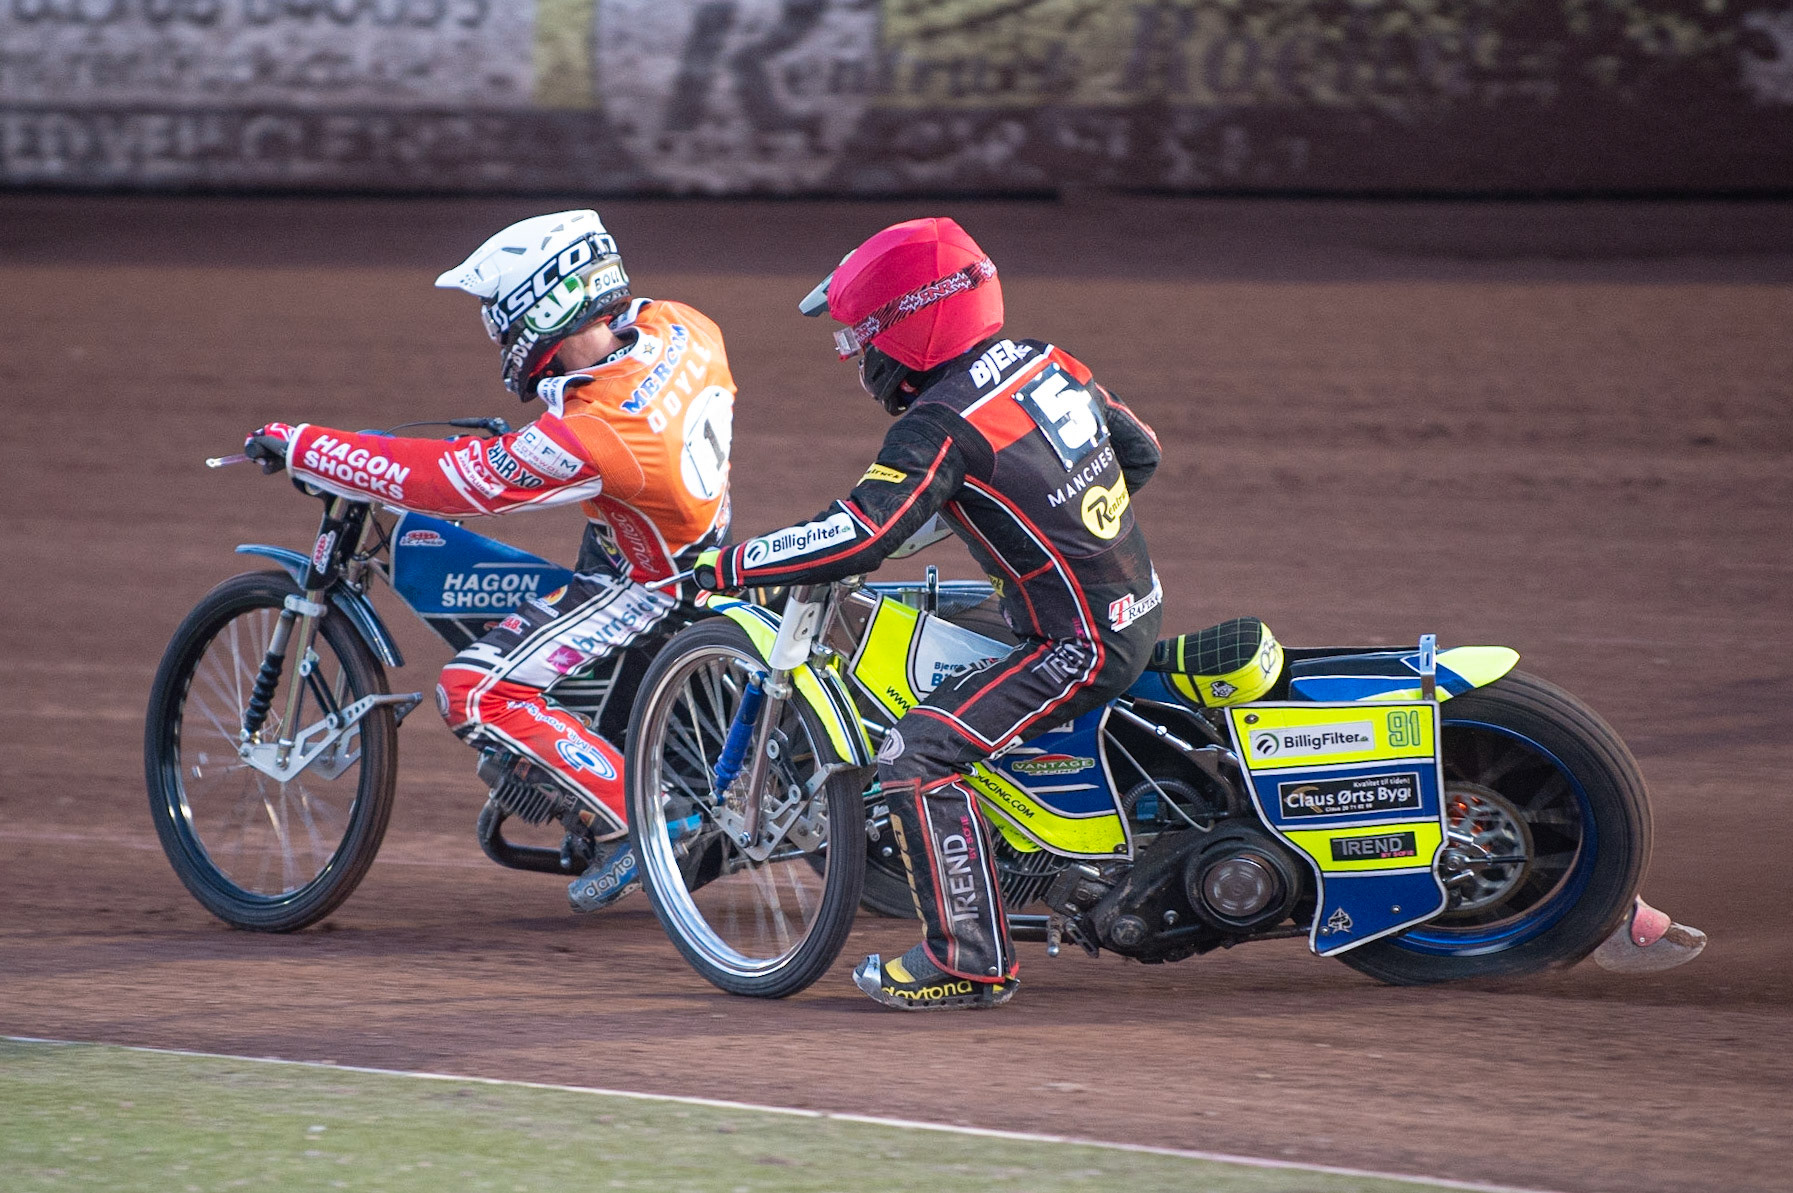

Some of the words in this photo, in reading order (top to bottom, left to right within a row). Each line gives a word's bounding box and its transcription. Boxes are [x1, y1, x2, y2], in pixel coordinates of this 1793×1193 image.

[1030, 372, 1098, 449] 5
[310, 434, 410, 485] HAGON
[703, 418, 726, 472] 1
[303, 450, 404, 499] SHOCKS
[442, 572, 541, 592] HAGON
[441, 591, 539, 609] SHOCKS
[1387, 710, 1421, 748] 91
[1014, 759, 1092, 770] VANTAGE
[1286, 792, 1335, 809] Claus
[1336, 789, 1376, 806] Ørts
[1332, 833, 1405, 856] TREND
[942, 833, 981, 923] TREND
[881, 979, 974, 1001] daytona
